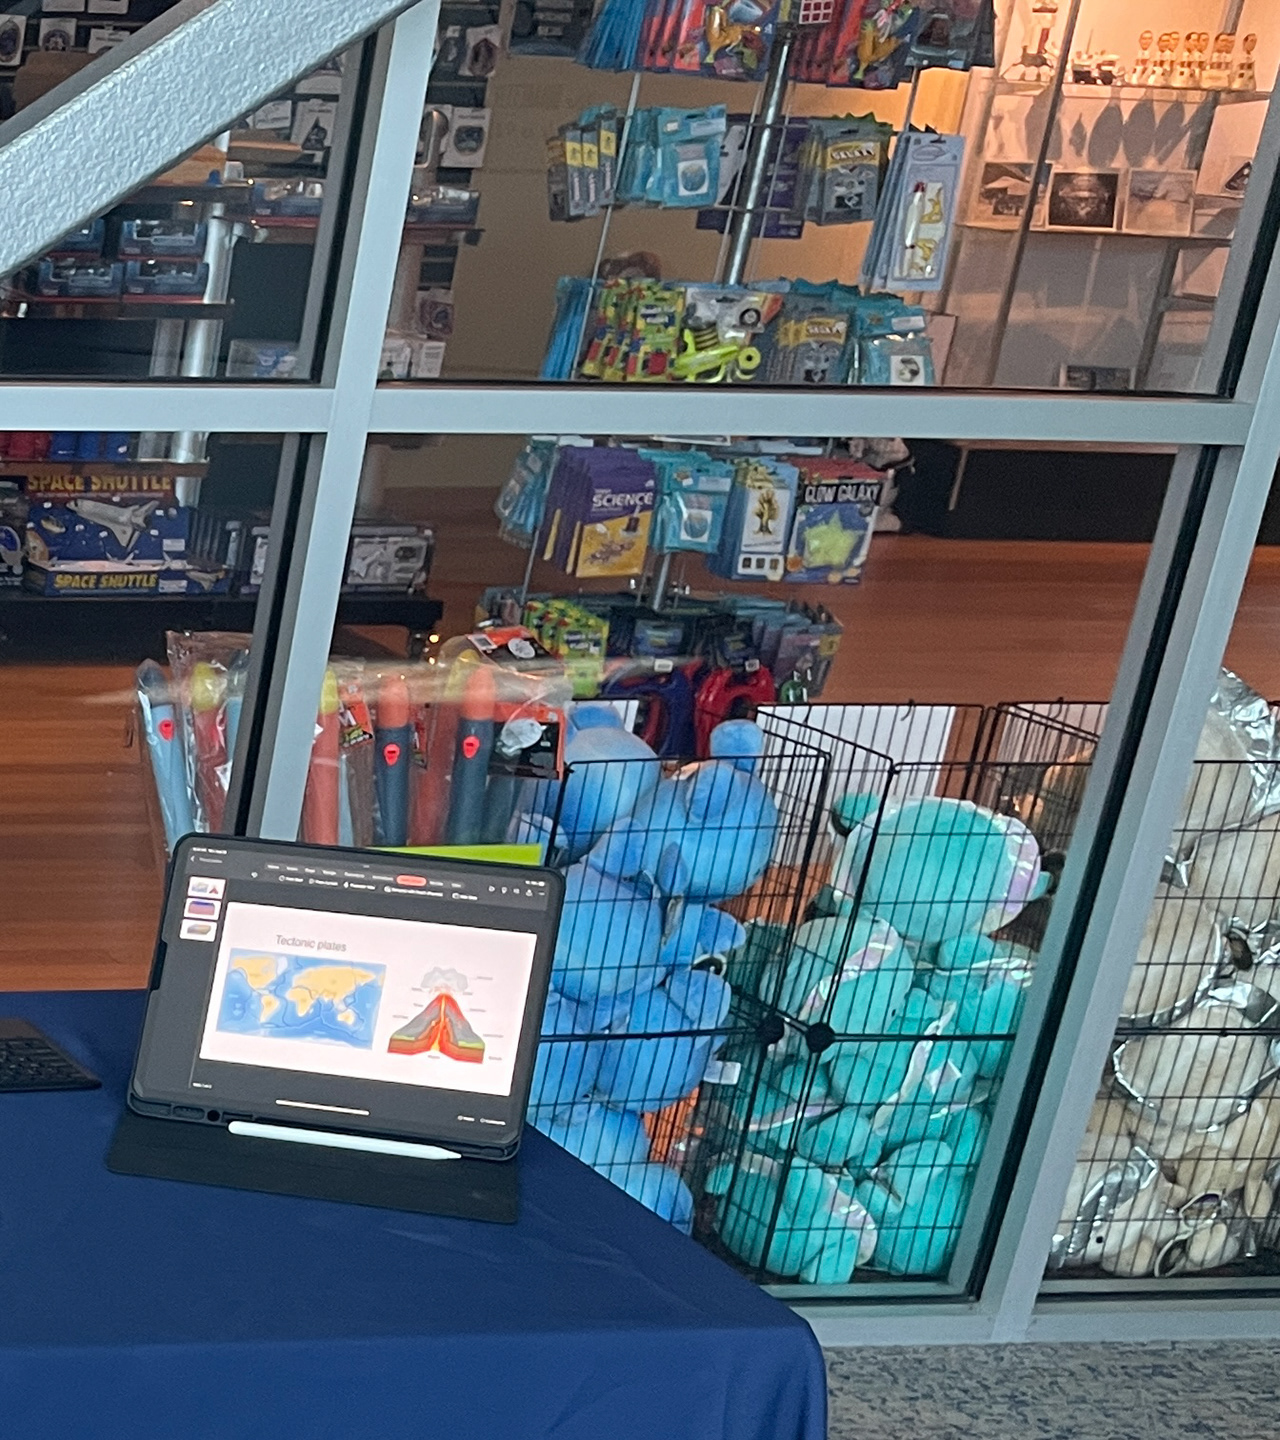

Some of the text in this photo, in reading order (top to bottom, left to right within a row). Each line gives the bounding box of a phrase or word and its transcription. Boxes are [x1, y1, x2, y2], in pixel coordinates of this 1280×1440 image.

[592, 491, 654, 507] SCIENCE
[53, 573, 157, 589] SPACE SHUTTLE
[276, 934, 348, 952] Tectonic plates
